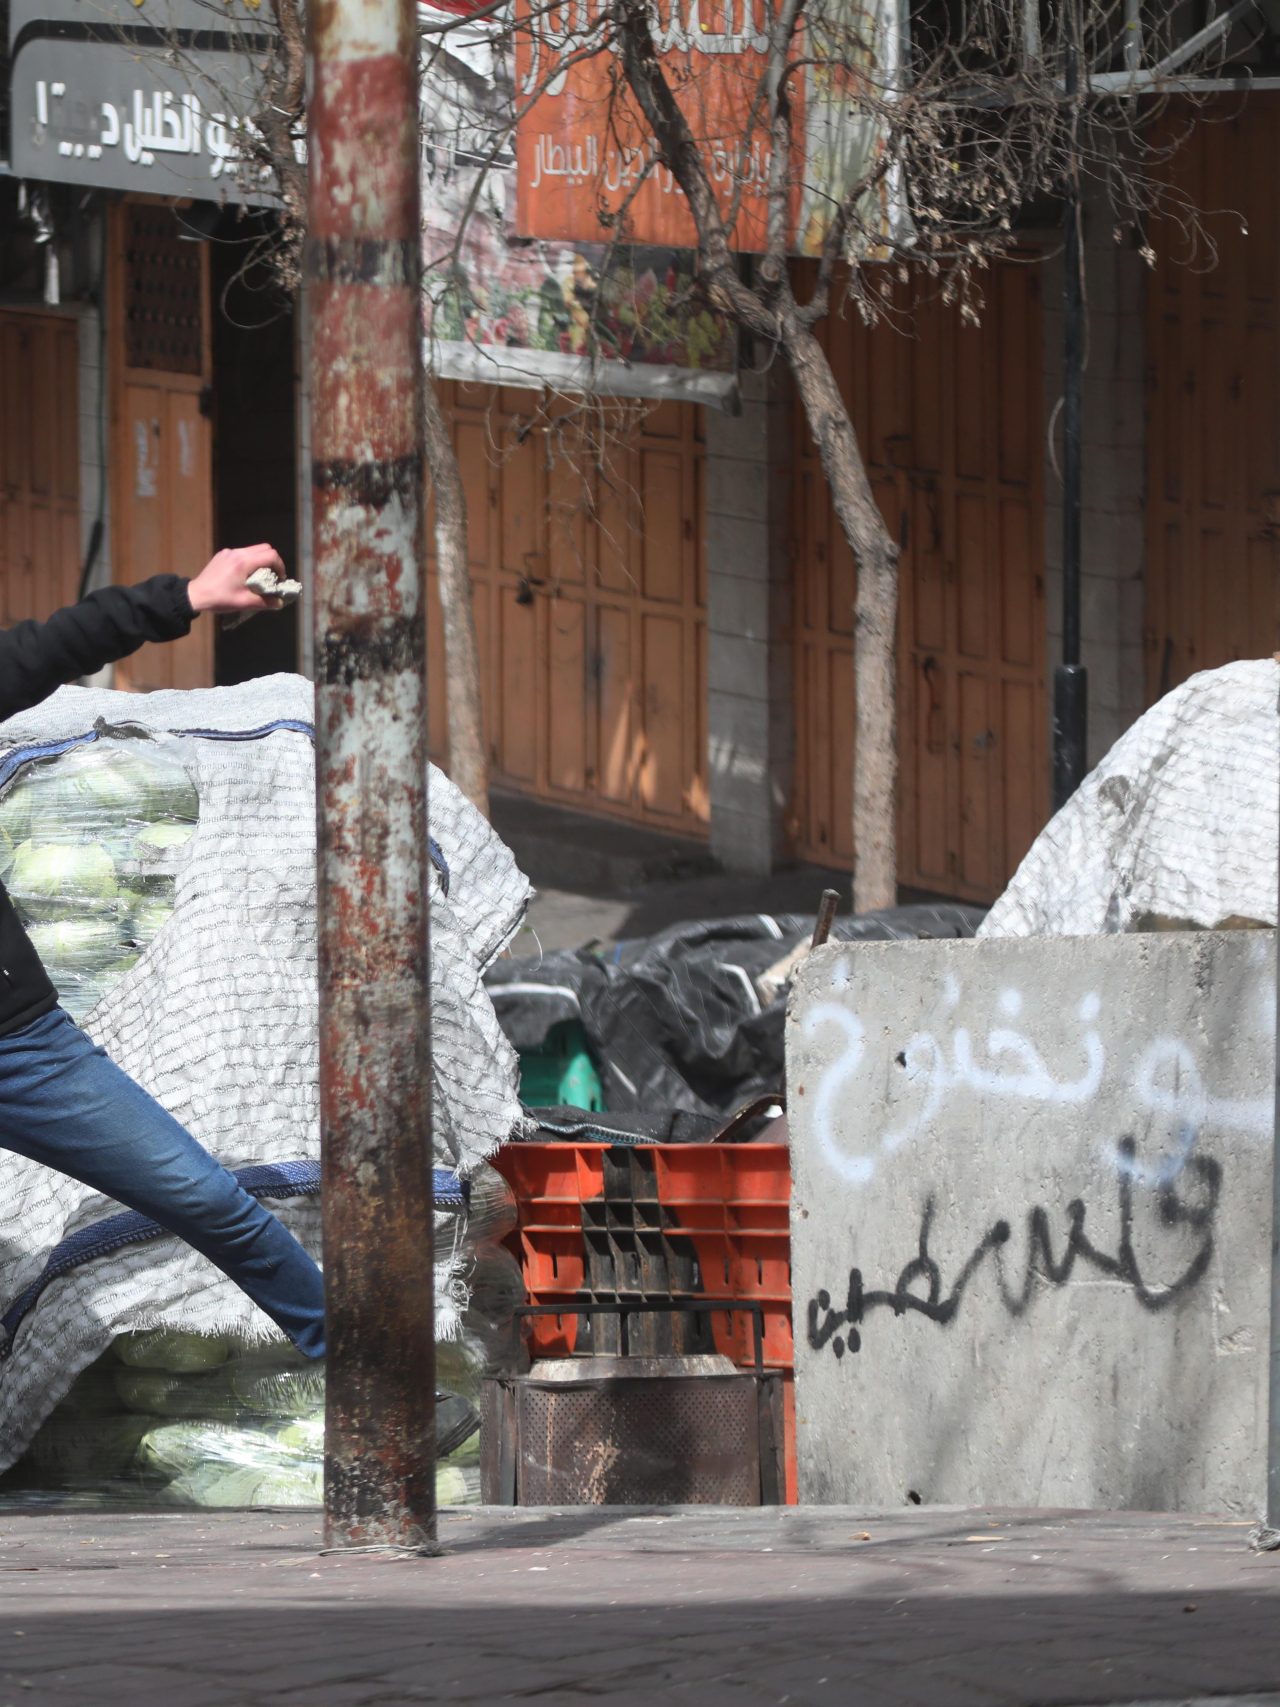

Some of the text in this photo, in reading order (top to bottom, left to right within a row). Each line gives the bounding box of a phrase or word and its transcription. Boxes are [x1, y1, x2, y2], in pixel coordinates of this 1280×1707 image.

[123, 89, 201, 166] الخليل
[529, 132, 599, 189] البيطار
[806, 1134, 1223, 1359] فلسطين
